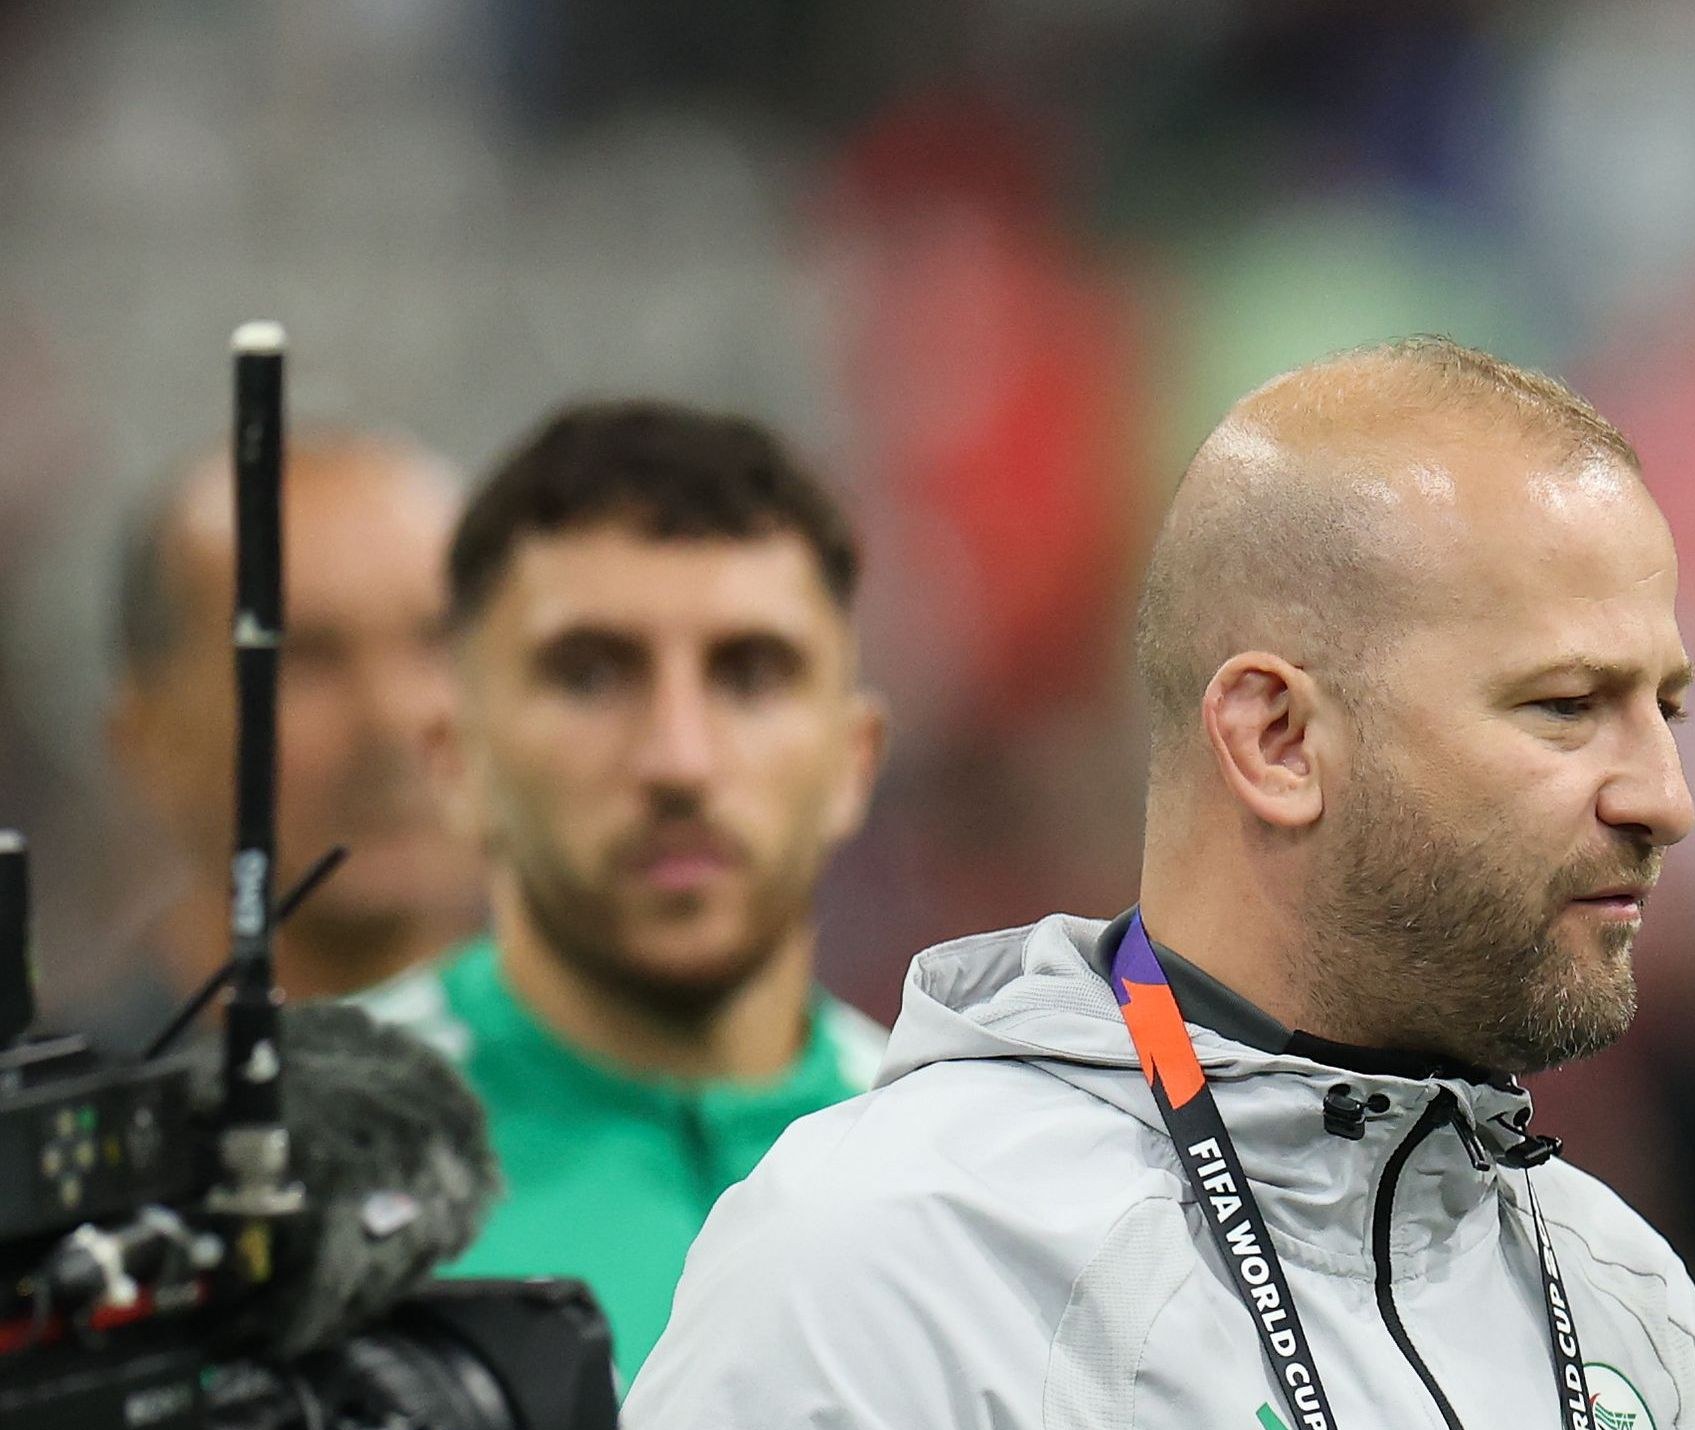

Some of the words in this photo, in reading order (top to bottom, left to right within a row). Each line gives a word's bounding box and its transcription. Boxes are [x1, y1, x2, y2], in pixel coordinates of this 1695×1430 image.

[1188, 1137, 1242, 1224] FIFA
[1226, 1219, 1297, 1357] WORLD
[1549, 1281, 1577, 1358] CUP
